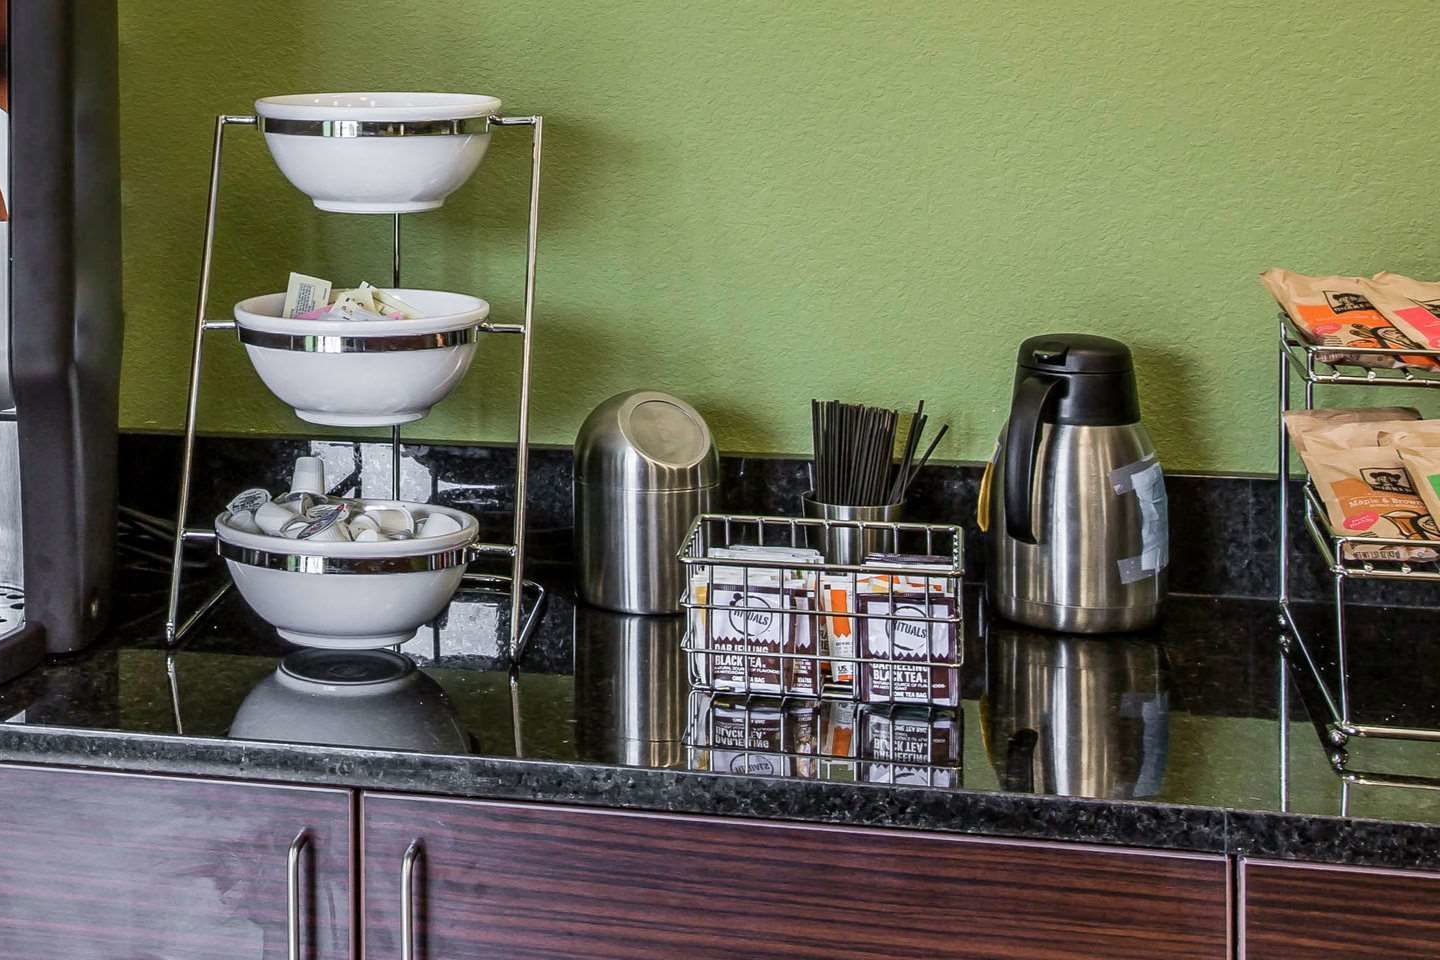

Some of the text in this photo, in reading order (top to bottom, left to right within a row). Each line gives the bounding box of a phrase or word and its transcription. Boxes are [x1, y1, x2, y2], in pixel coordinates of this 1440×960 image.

[733, 609, 769, 626] RIUALS
[714, 643, 769, 653] DARJELING
[715, 654, 766, 668] BLACK EA.
